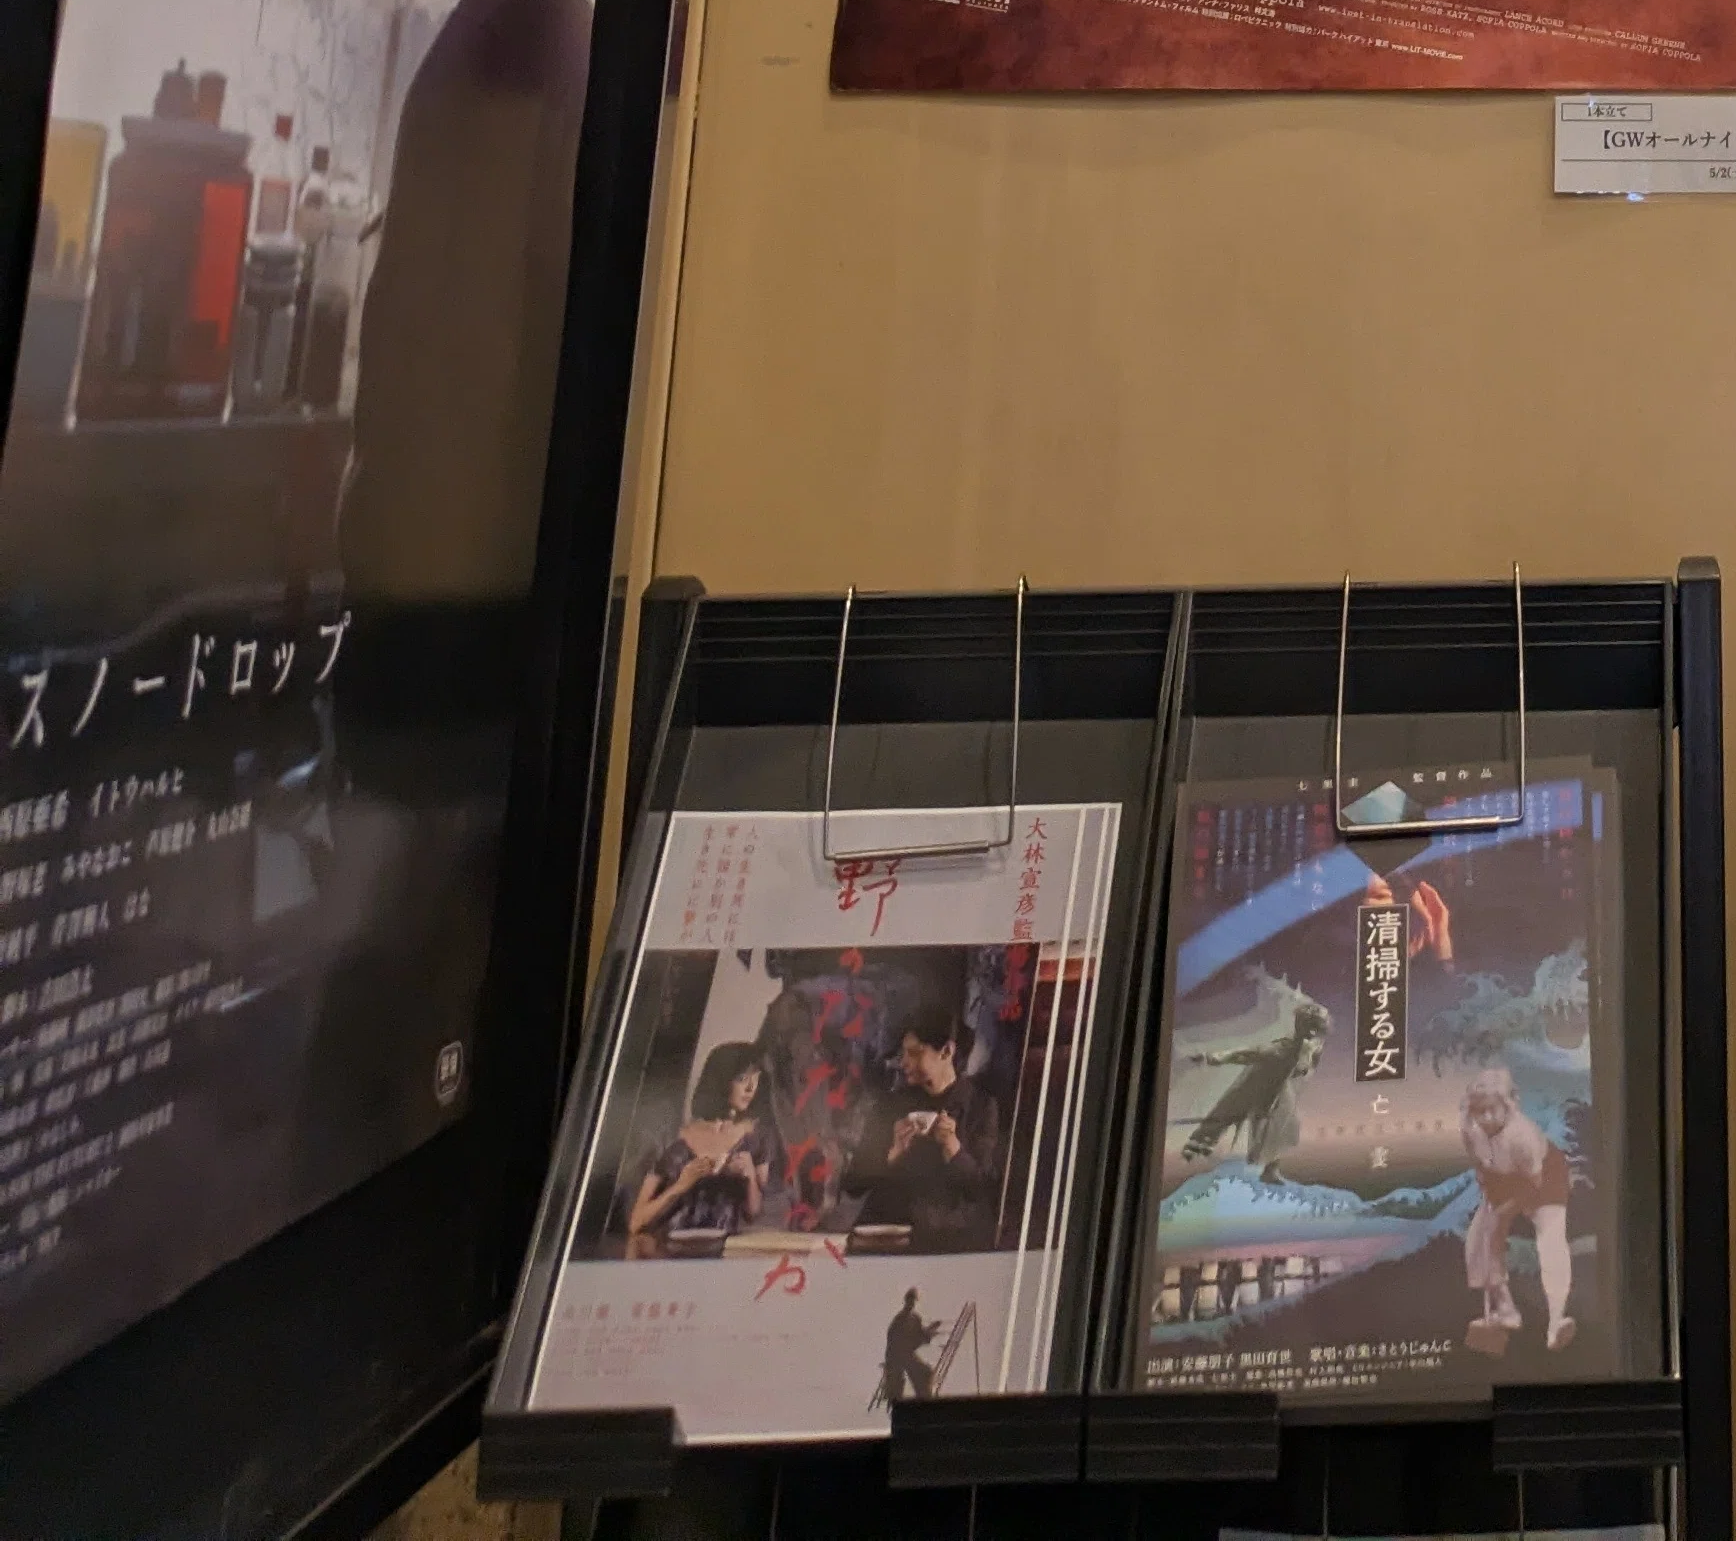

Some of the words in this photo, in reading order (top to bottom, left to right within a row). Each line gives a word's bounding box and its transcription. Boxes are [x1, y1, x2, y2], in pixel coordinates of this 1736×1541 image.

[10, 610, 353, 750] スノードロップ
[1363, 910, 1401, 1080] 清掃する女
